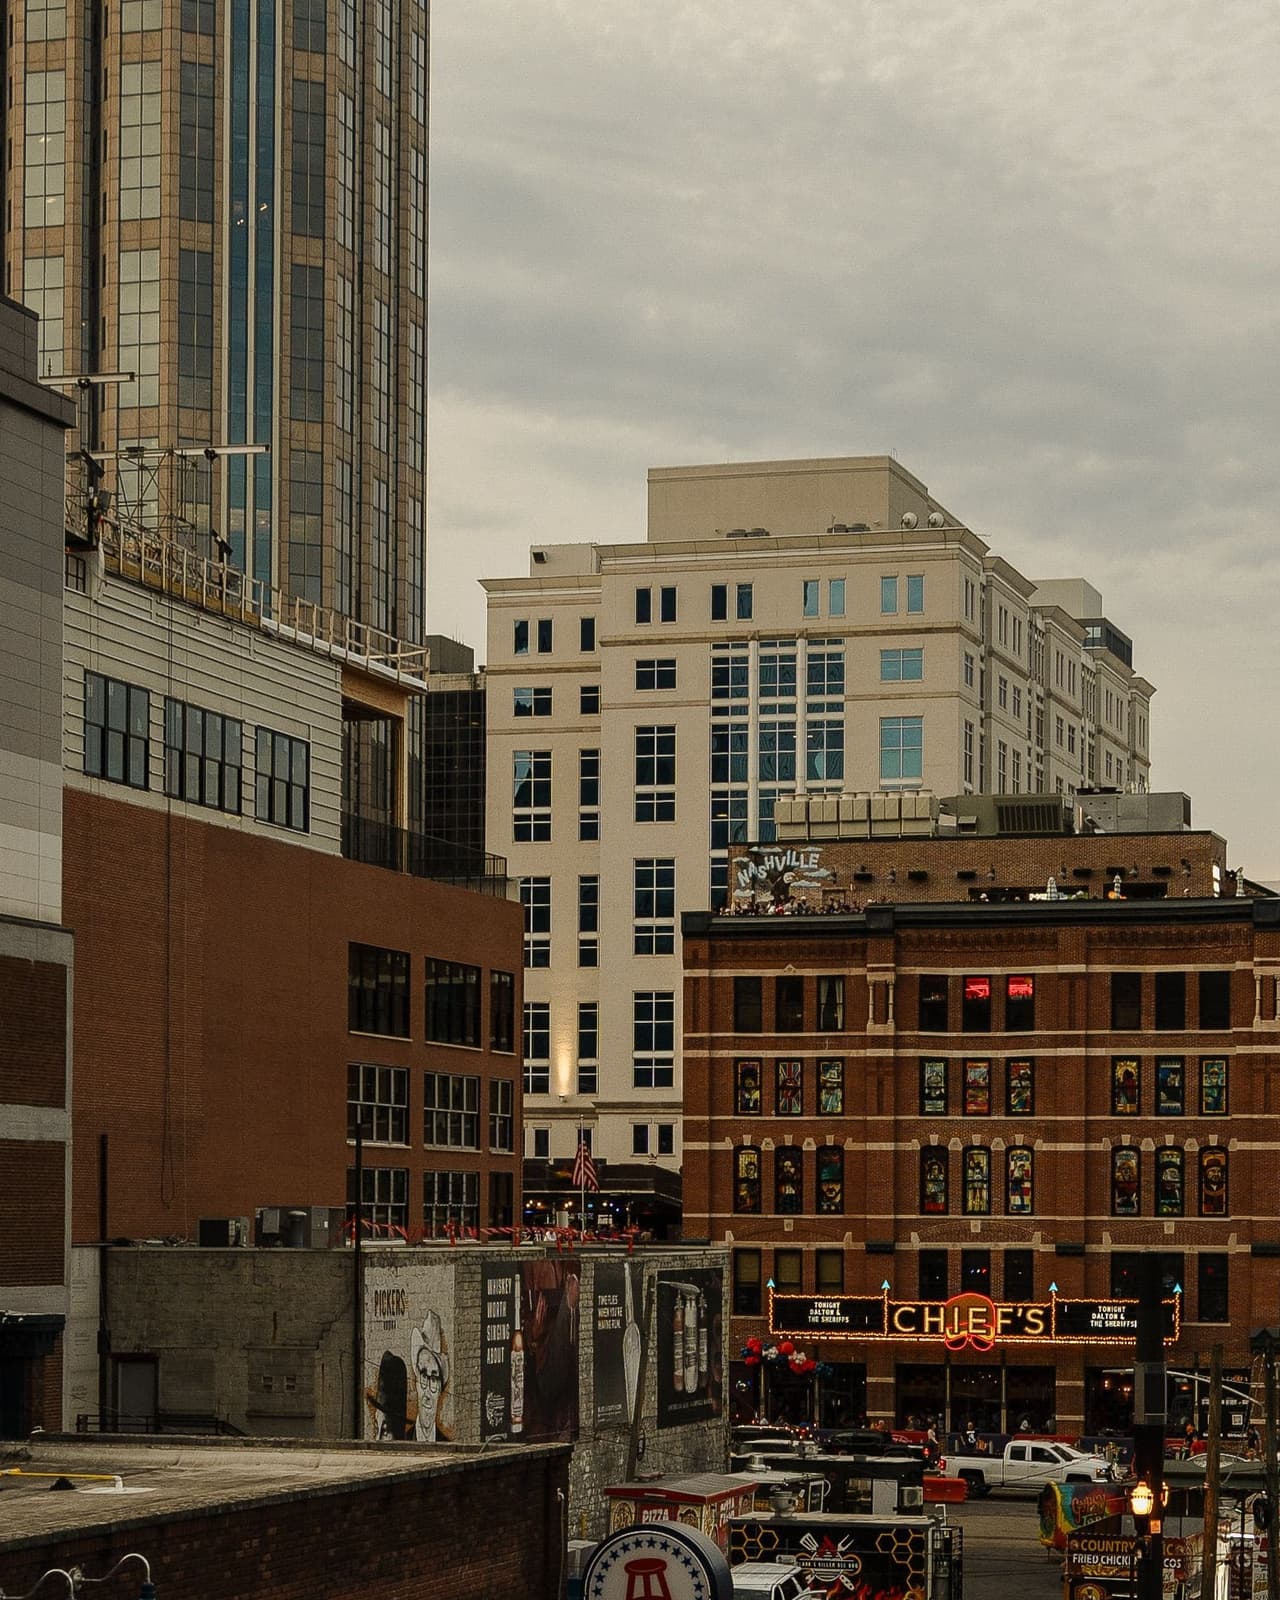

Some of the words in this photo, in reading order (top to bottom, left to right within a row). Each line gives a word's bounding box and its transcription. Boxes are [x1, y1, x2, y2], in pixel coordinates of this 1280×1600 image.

[737, 849, 820, 887] NASHVILLE
[487, 1278, 512, 1296] WHISKEY
[374, 1288, 406, 1317] PICKERS
[1099, 1305, 1126, 1313] TONIGHT
[809, 1308, 835, 1316] DALTON
[835, 1308, 841, 1316] &
[821, 1316, 849, 1324] SHERIFFS
[894, 1306, 1045, 1334] CHIEF'S
[1090, 1320, 1103, 1328] THE
[1104, 1320, 1135, 1328] SHERIFFS
[642, 1508, 669, 1524] PIZZA
[1081, 1539, 1136, 1552] COUNTRY
[1073, 1554, 1099, 1565] FRIED
